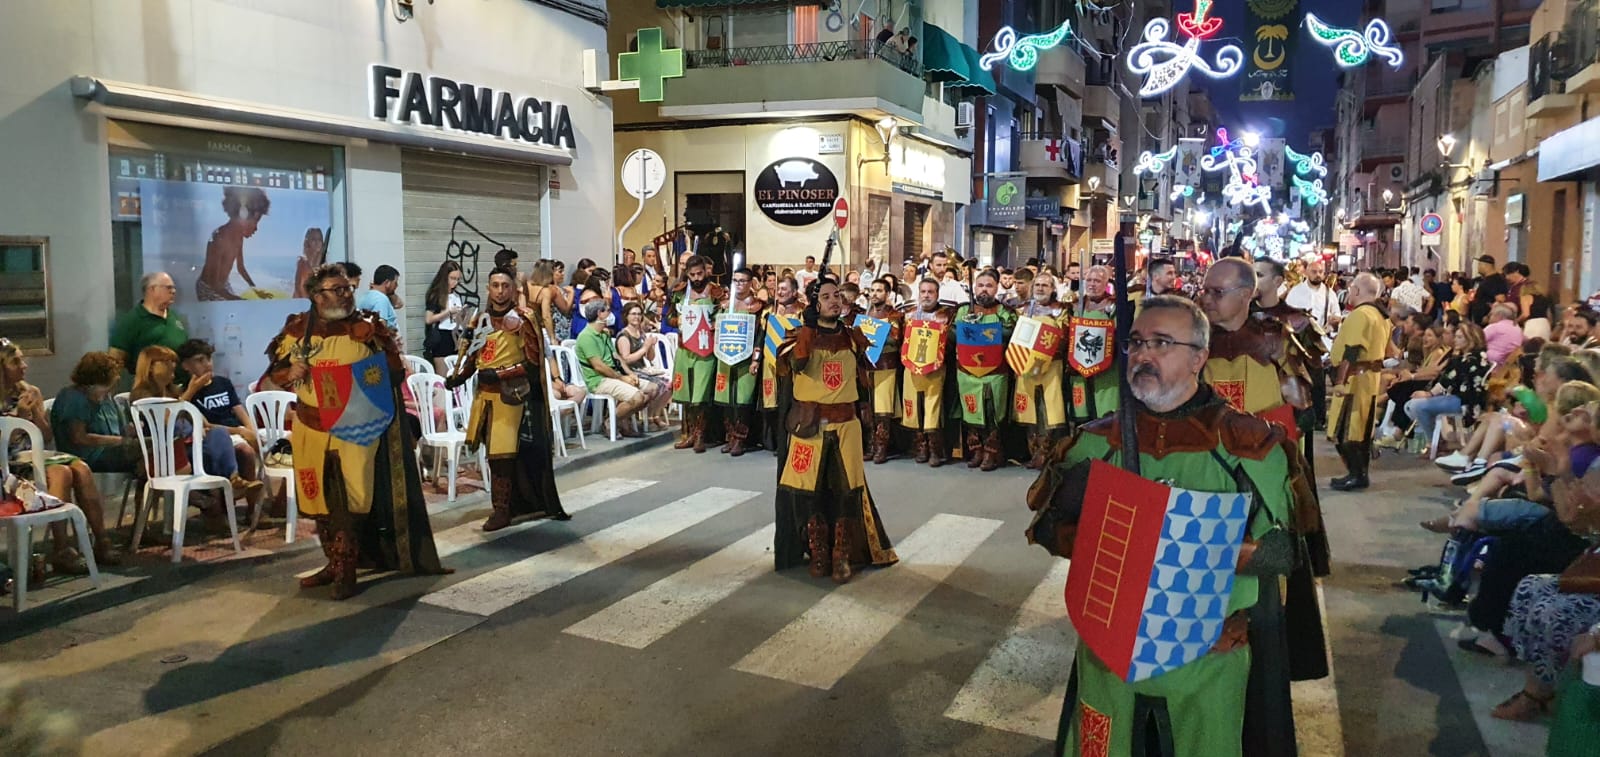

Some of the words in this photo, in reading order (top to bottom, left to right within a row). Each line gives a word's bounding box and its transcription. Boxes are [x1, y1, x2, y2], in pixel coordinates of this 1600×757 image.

[373, 65, 576, 149] FARMACIA
[207, 141, 252, 153] FARMACIA
[758, 189, 774, 200] EL
[778, 188, 834, 200] PINOSER
[196, 391, 230, 410] VANS
